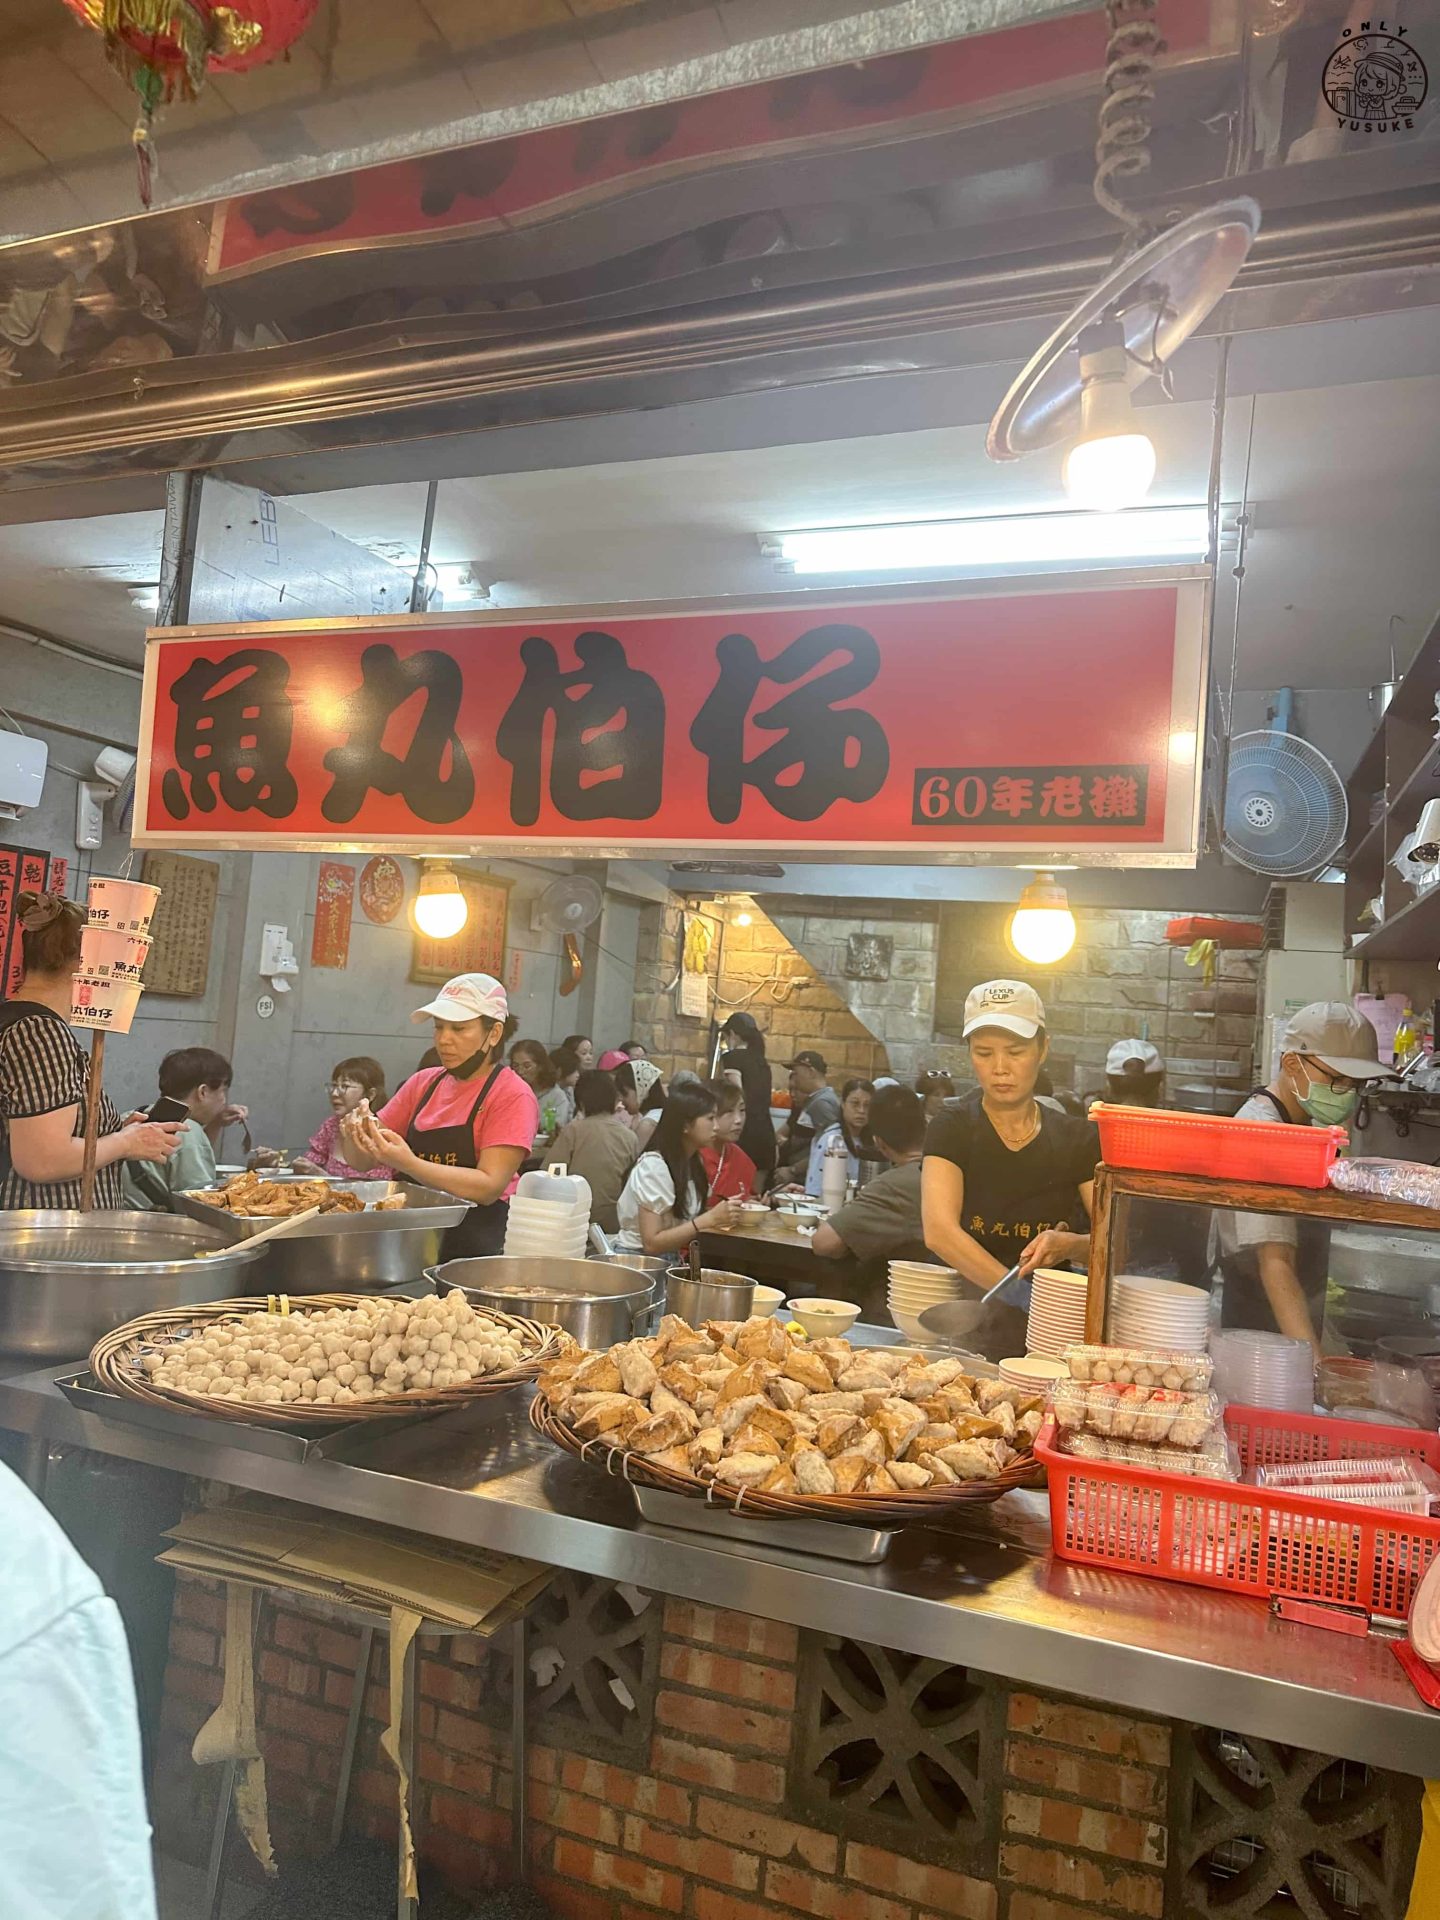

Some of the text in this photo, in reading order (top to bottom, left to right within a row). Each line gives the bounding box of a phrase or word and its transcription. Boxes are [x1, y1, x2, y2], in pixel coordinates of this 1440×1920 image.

[161, 625, 890, 826] 魚丸伯仔
[113, 961, 142, 975] 魚丸
[988, 987, 1015, 995] LEXUS
[71, 1004, 113, 1019] 丸伯仔
